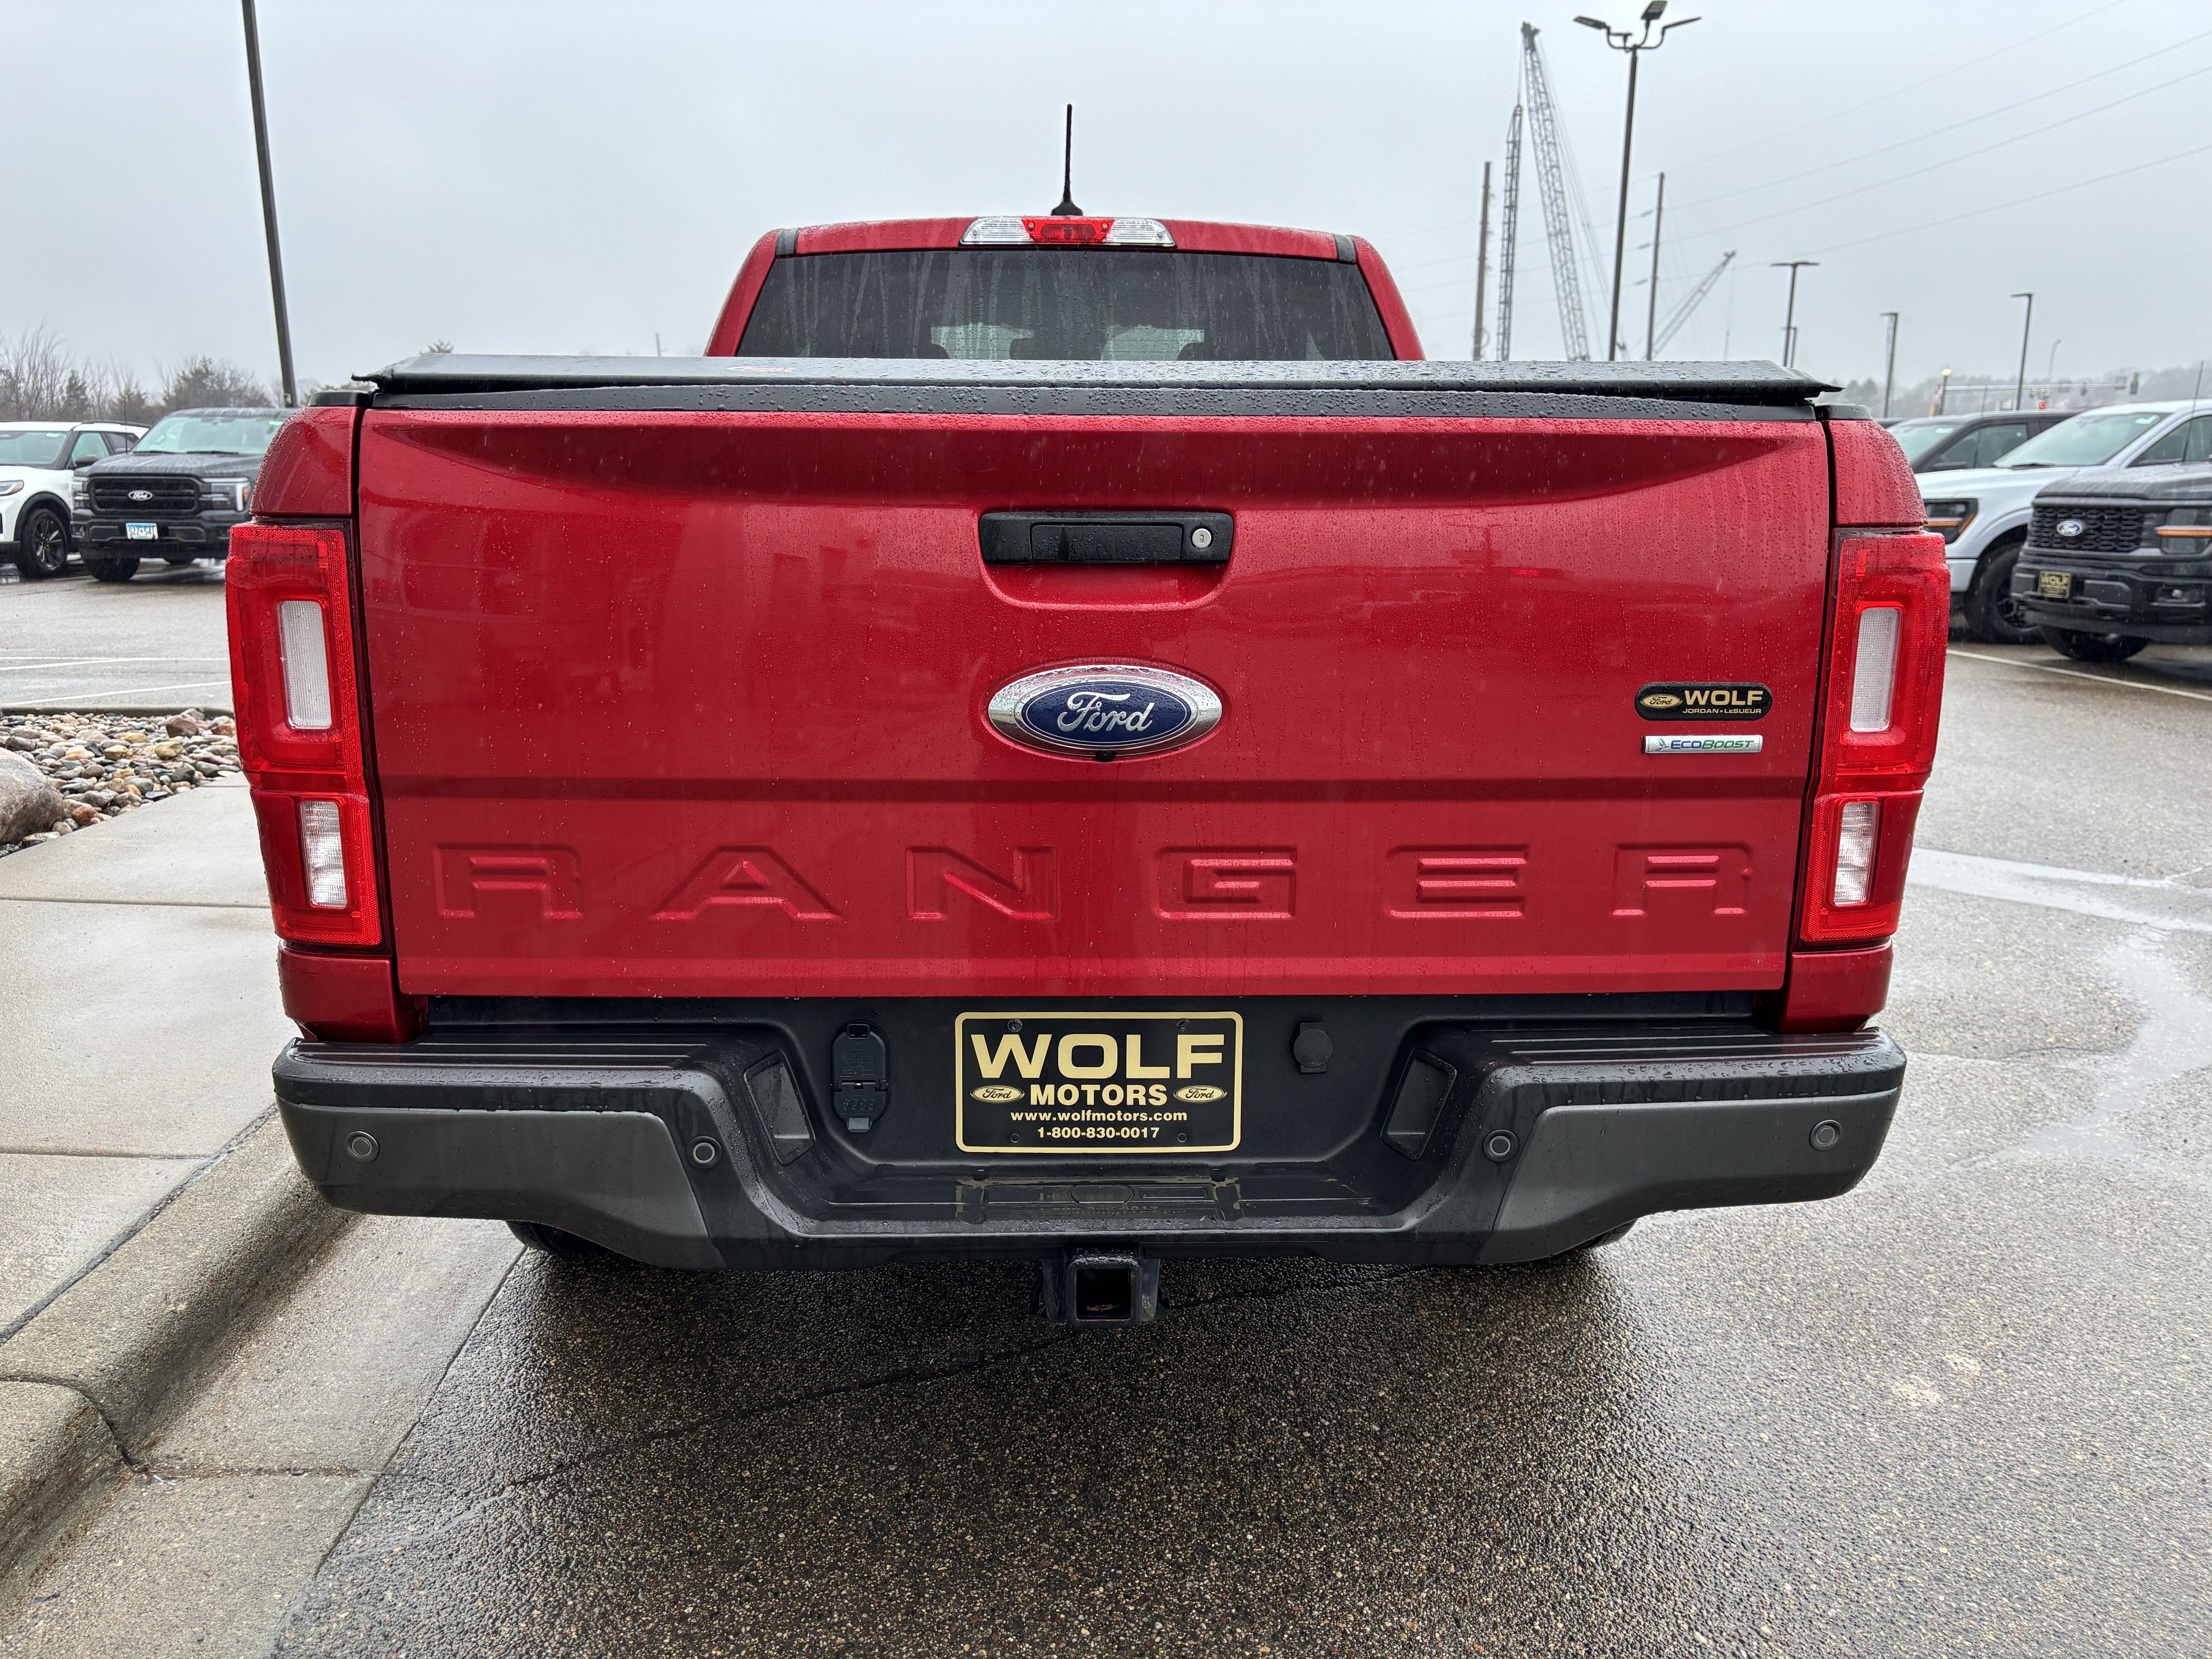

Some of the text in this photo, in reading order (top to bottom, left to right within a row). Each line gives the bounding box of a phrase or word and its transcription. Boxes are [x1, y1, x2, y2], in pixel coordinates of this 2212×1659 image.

[1650, 696, 1672, 705] Ford
[1685, 690, 1763, 705] WOLF
[1057, 691, 1154, 732] Ford
[430, 843, 1753, 924] RANGER
[971, 1034, 1224, 1079] WOLF
[982, 1088, 1012, 1098] Ford
[1030, 1084, 1167, 1105] MOTORS
[1185, 1088, 1214, 1098] Ford
[1011, 1110, 1187, 1121] www.wolfmotors.com
[1037, 1127, 1160, 1138] 1-800-830-0017
